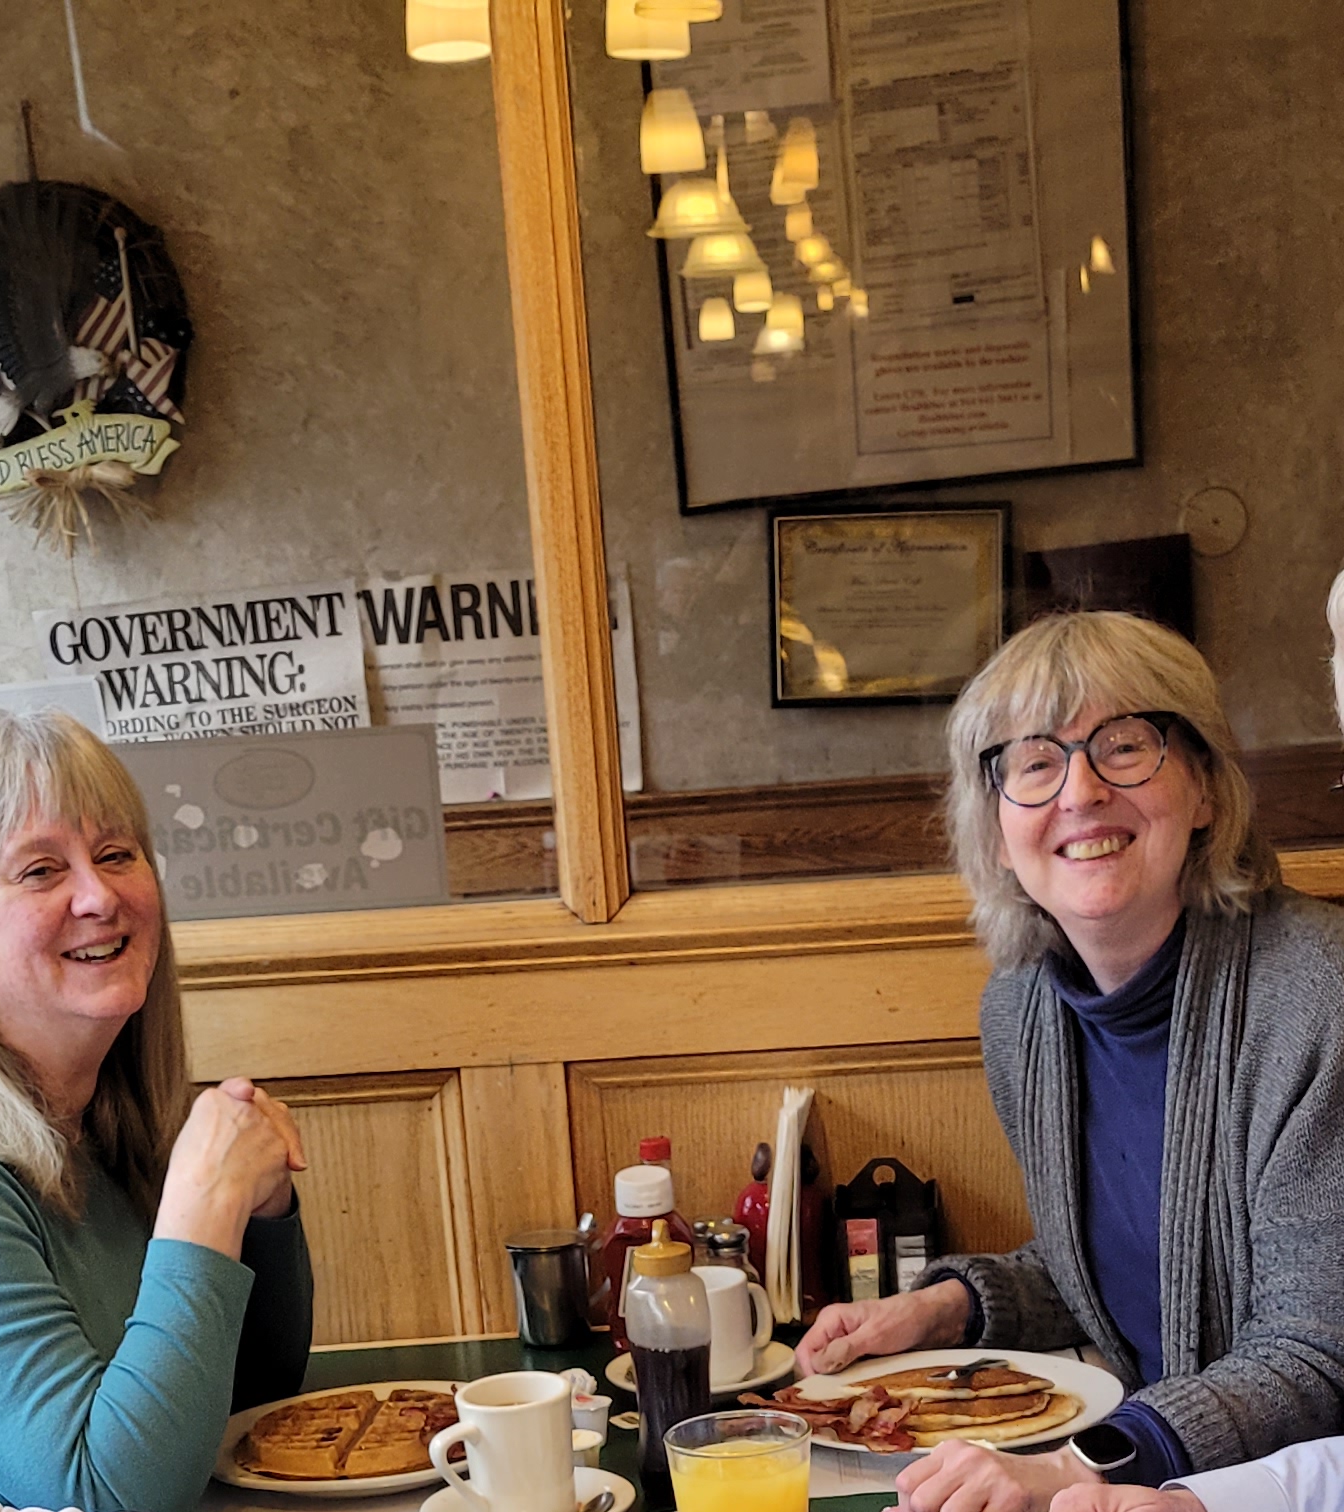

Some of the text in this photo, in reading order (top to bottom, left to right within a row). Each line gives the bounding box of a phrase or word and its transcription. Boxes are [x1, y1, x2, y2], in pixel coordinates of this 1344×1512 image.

[14, 439, 74, 473] BLESS
[77, 422, 157, 458] AMERICA
[50, 592, 347, 667] GOVERNMENT
[101, 651, 307, 712] WARNING:
[185, 710, 213, 729] TO
[217, 705, 258, 725] THE
[263, 695, 358, 721] SURGEON
